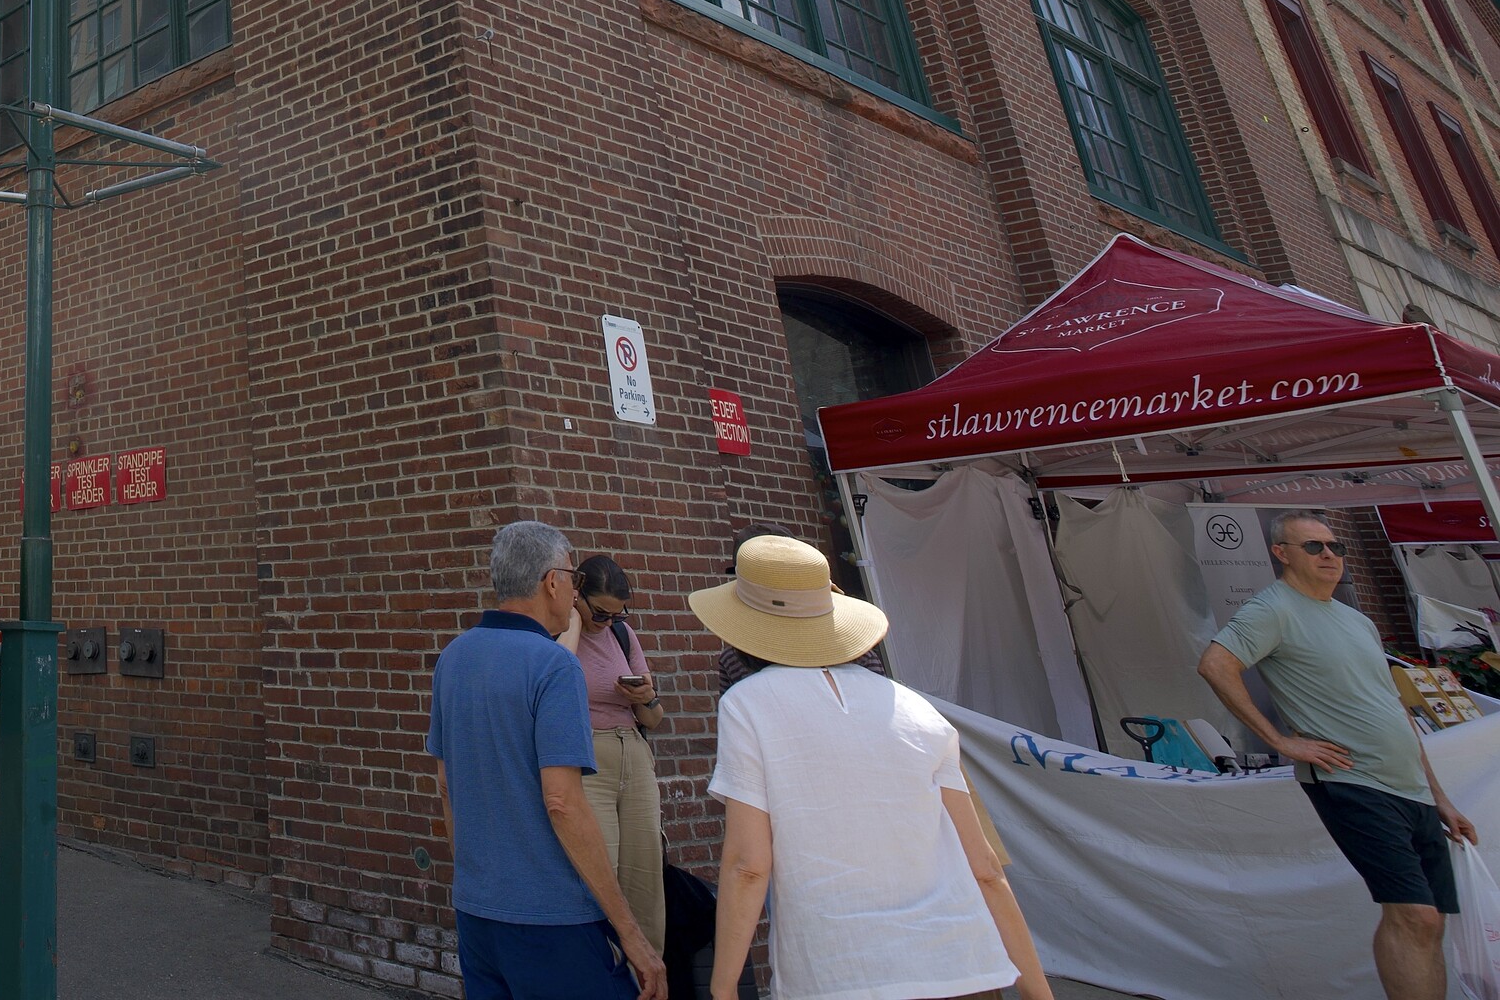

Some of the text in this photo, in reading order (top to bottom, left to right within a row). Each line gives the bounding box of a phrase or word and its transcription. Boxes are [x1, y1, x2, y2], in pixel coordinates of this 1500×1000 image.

[1044, 300, 1186, 331] LAWRENCE
[1057, 318, 1130, 338] MARKET
[626, 375, 637, 387] No
[925, 370, 1364, 441] stlawrencemarket.com
[67, 457, 109, 478] SPRINKLER
[118, 450, 163, 471] STANDPIPE
[77, 473, 97, 490] TEST
[129, 467, 151, 483] TEST
[71, 487, 104, 505] HEADER
[123, 481, 158, 499] HEADER
